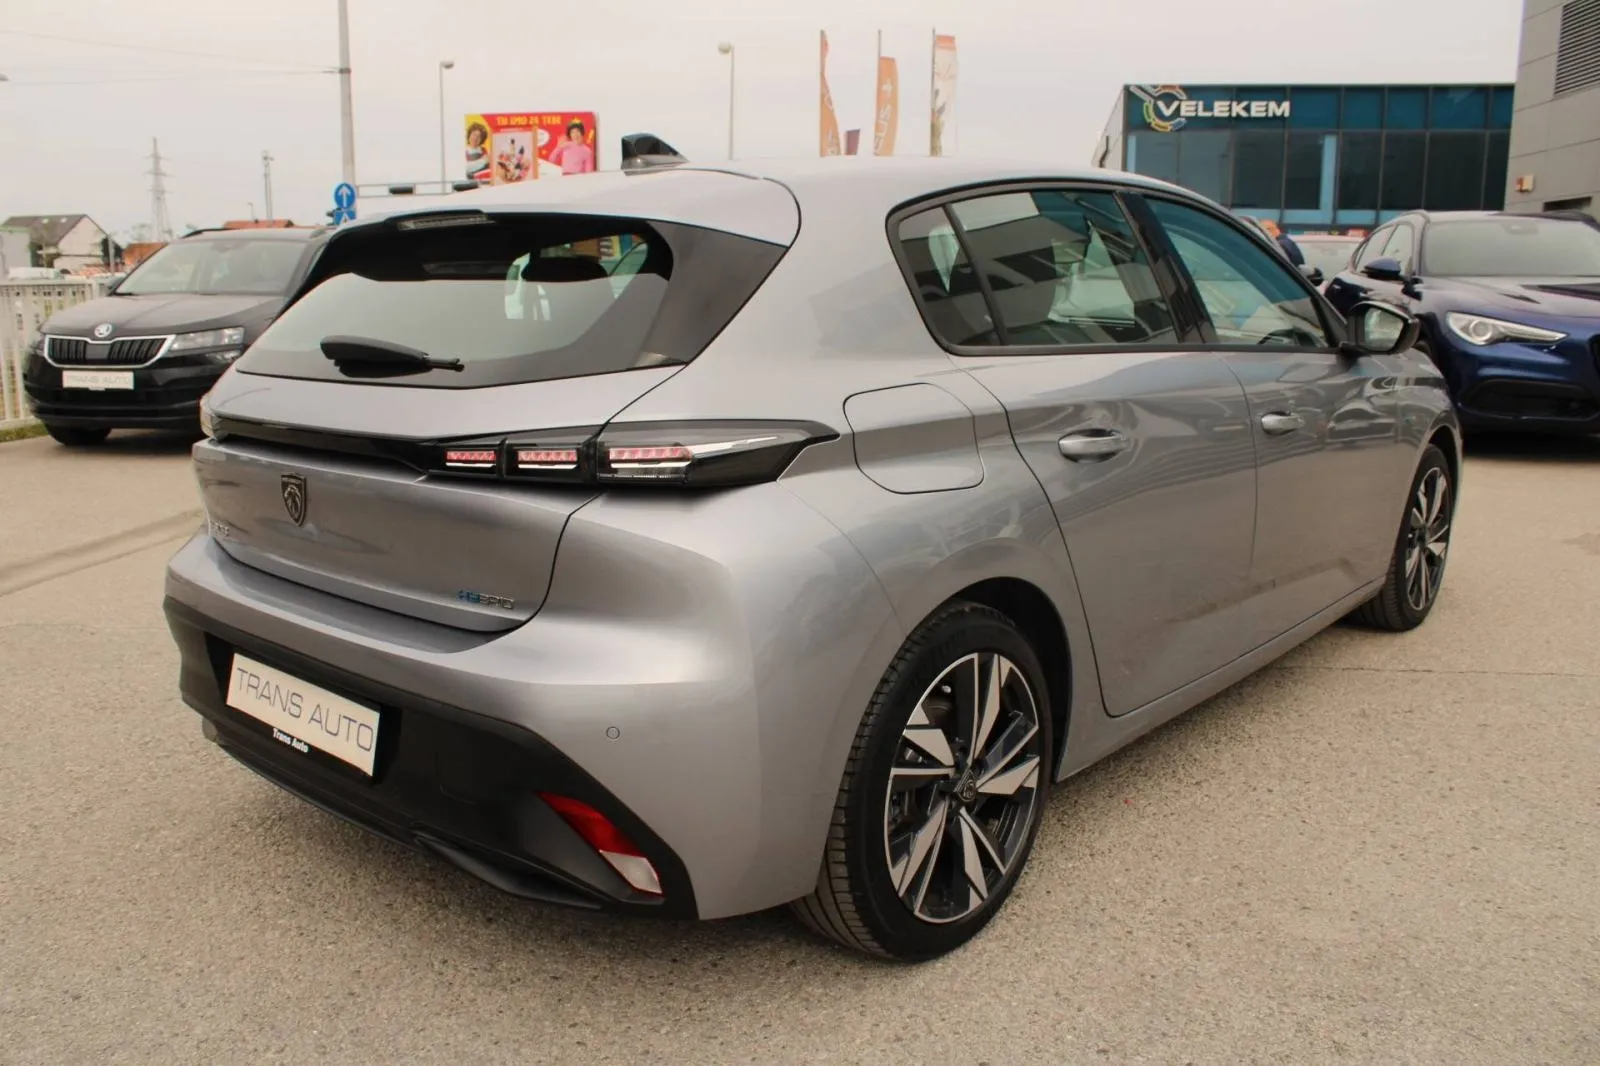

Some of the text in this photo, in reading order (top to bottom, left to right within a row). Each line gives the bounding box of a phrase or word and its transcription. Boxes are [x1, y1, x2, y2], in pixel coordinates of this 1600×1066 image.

[1156, 100, 1290, 118] VELEKEM
[238, 668, 375, 752] TRANS AUTO
[273, 728, 309, 754] Trans Auto
